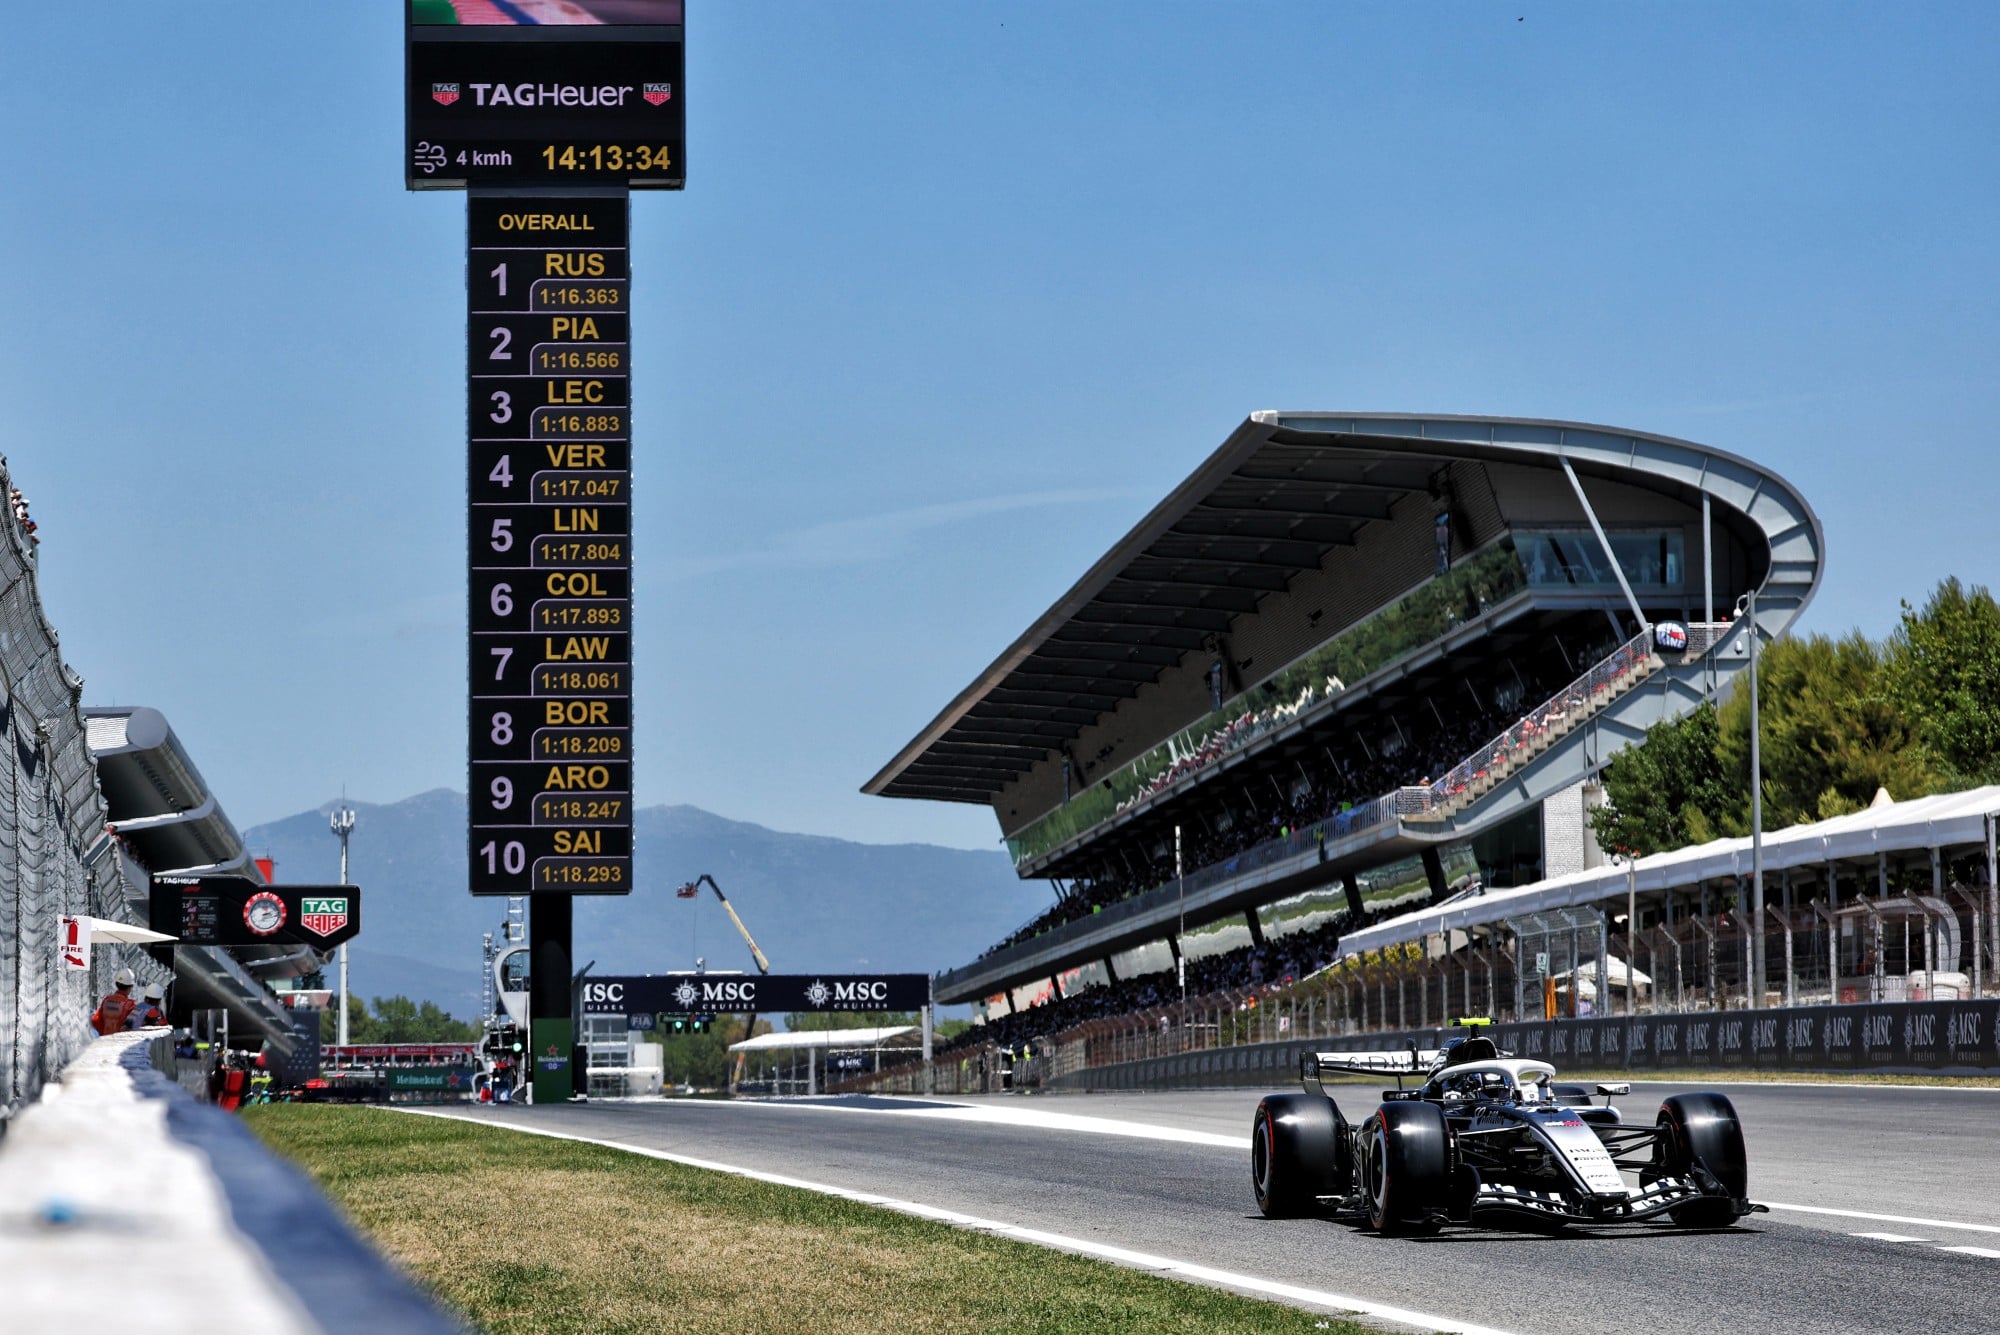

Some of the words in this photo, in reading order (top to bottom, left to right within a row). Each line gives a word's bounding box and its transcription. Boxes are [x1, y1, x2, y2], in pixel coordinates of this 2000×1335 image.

[456, 151, 467, 165] 4
[473, 151, 512, 165] kmh
[543, 146, 670, 170] 14:13:34
[499, 215, 594, 230] OVERALL
[546, 254, 605, 275] RUS
[491, 263, 507, 296] 1
[540, 289, 618, 304] 1:16.363
[552, 318, 600, 339] PIA
[489, 327, 512, 360] 2
[540, 353, 619, 368] 1:16.566
[548, 381, 604, 403] LEC
[490, 391, 512, 424] 3
[541, 416, 620, 432] 1:16.883
[546, 445, 606, 467] VER
[489, 455, 514, 488] 4
[541, 480, 620, 496] 1:17.047
[554, 509, 598, 531] LIN
[491, 519, 513, 552] 5
[541, 544, 620, 560] 1:17.804
[547, 573, 607, 595] COL
[491, 583, 513, 616] 6
[541, 609, 620, 624] 1:17.893
[546, 637, 609, 659] LAW
[491, 648, 513, 680] 7
[541, 673, 619, 689] 1:18.061
[546, 702, 609, 724] BOR
[491, 712, 513, 745] 8
[542, 737, 621, 753] 1:18.209
[544, 766, 609, 789] ARO
[491, 776, 513, 810] 9
[542, 802, 621, 818] 1:18.247
[553, 831, 601, 853] SAI
[480, 841, 526, 875] 10
[542, 867, 621, 882] 1:18.293
[305, 901, 343, 912] TAG
[304, 915, 345, 933] HEUER
[702, 983, 755, 1001] MSC
[834, 982, 887, 1000] MSC
[631, 1015, 652, 1027] FIA
[1832, 1017, 1851, 1046] MSC
[1872, 1015, 1892, 1045] MSC
[1914, 1014, 1935, 1045] MSC
[1958, 1012, 1981, 1045] MSC
[1662, 1024, 1678, 1050] MSC
[1693, 1023, 1709, 1049] MSC
[1726, 1021, 1742, 1048] MSC
[1760, 1019, 1777, 1047] MSC
[1795, 1018, 1813, 1047] MSC
[396, 1074, 443, 1085] Heineken
